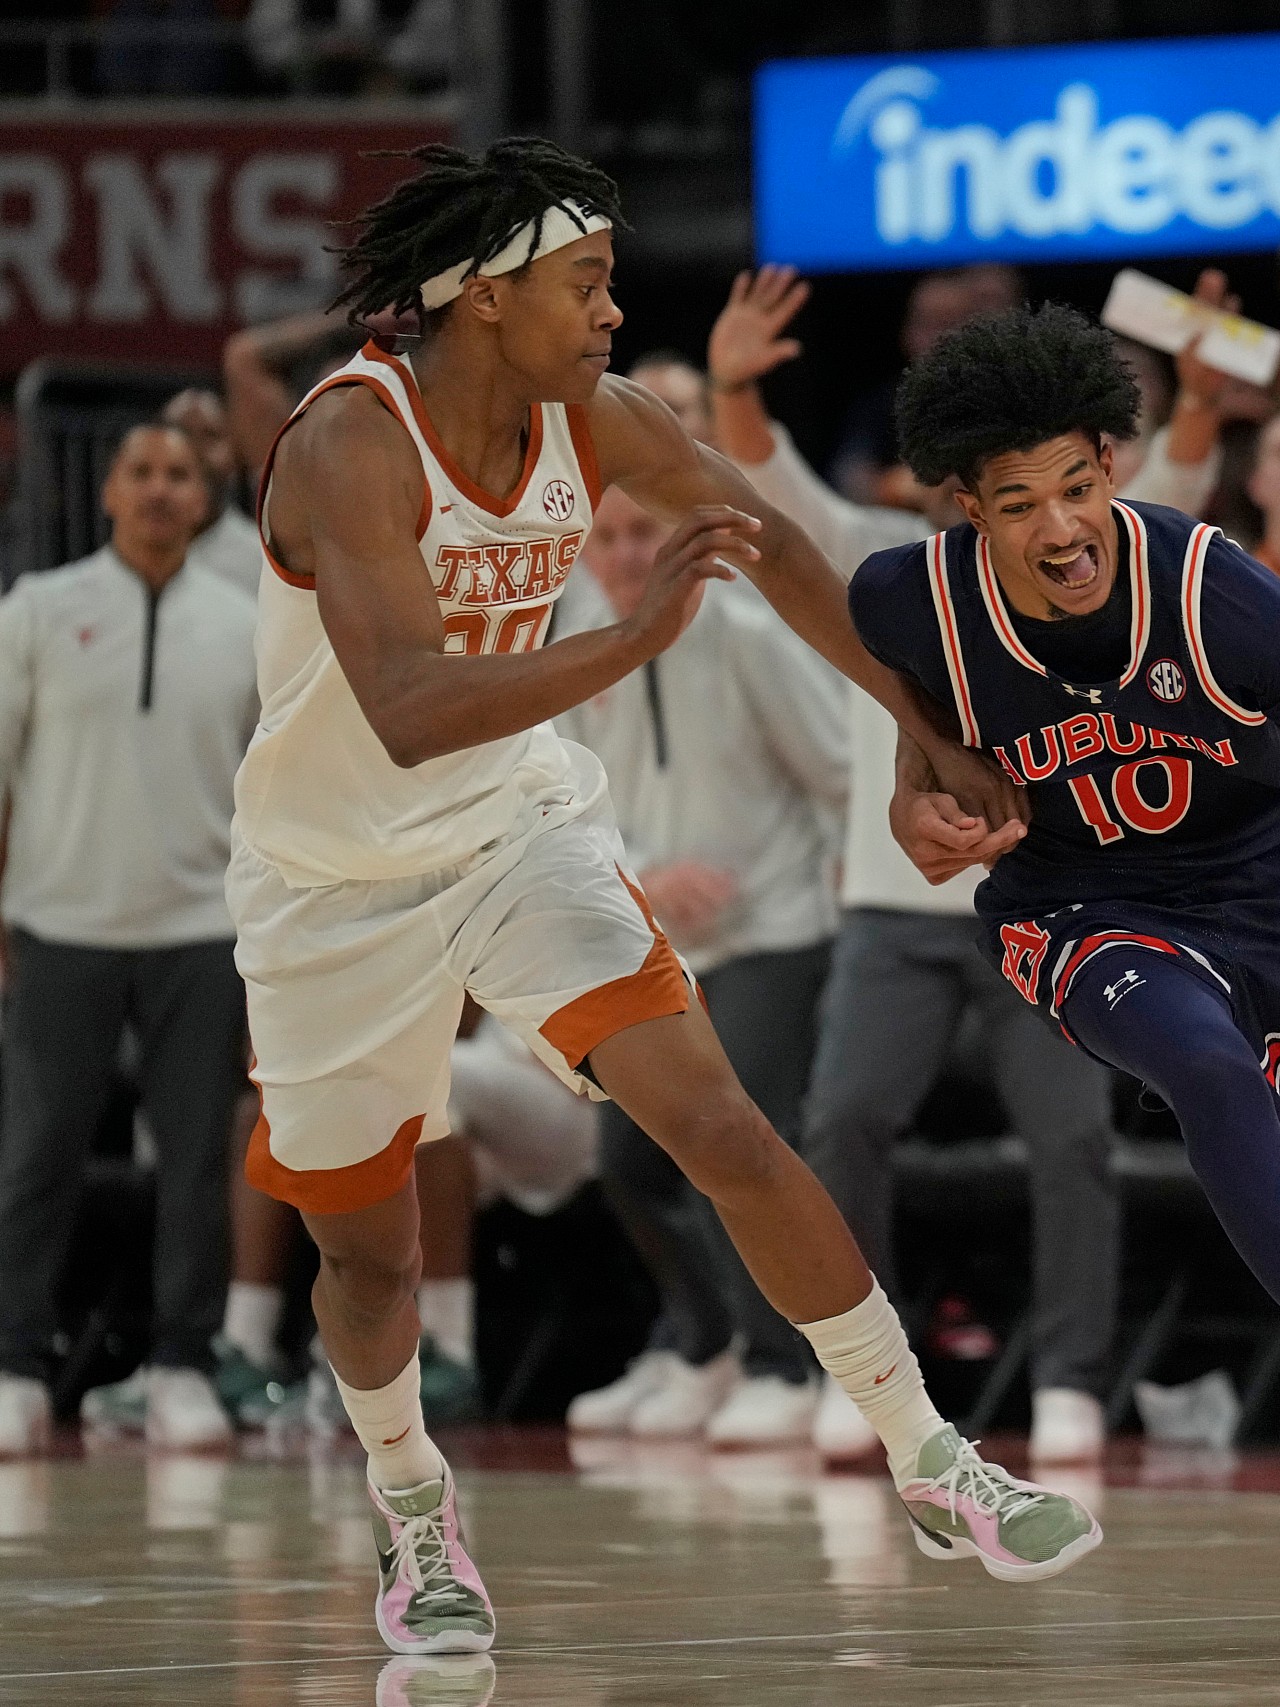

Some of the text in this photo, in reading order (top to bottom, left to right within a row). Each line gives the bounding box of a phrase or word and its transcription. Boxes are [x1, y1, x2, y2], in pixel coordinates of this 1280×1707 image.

[543, 480, 575, 522] SEC
[434, 529, 584, 607] TEXAS
[1150, 661, 1183, 700] SEC
[992, 712, 1239, 786] AUBURN
[1067, 755, 1193, 847] 10
